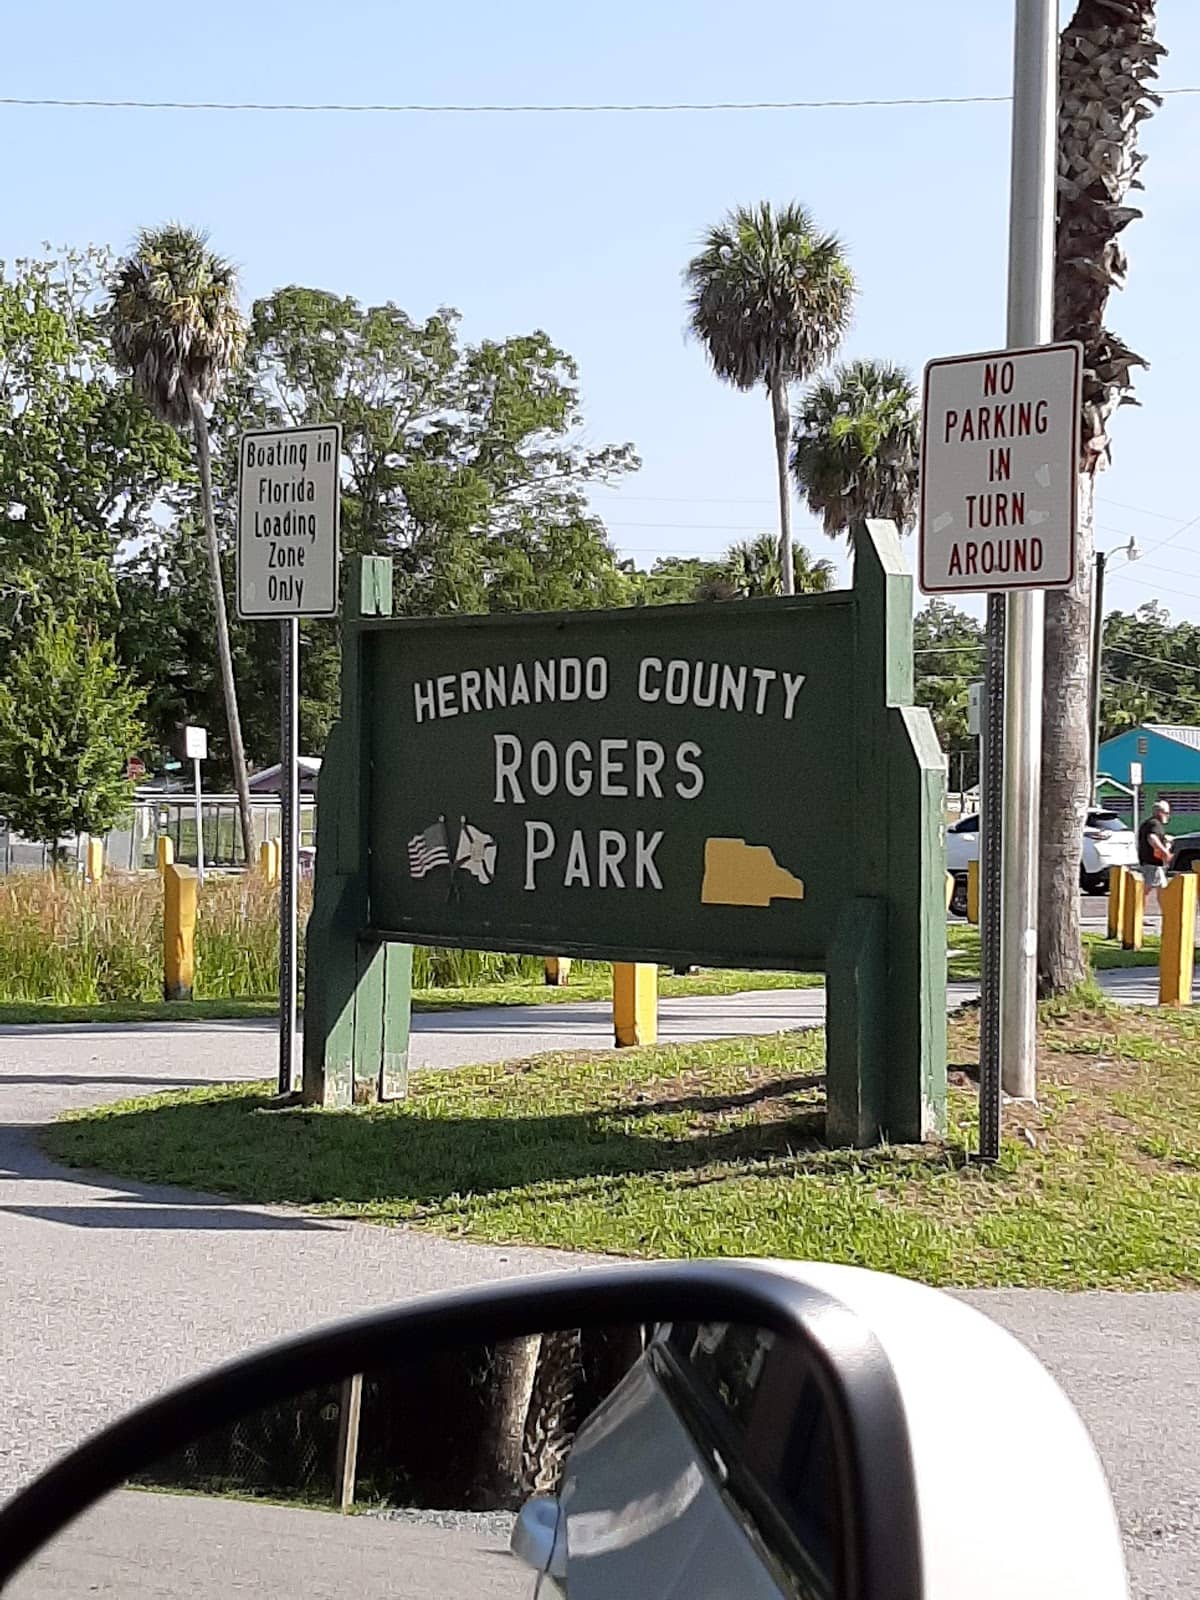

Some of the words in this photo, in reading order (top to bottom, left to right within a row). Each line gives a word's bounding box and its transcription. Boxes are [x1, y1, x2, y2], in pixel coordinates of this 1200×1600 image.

[984, 361, 1014, 397] NO
[945, 400, 1048, 443] PARKING
[247, 440, 307, 471] Boating
[317, 435, 331, 463] in
[988, 448, 1010, 482] IN
[259, 477, 314, 505] Florida
[255, 510, 316, 543] Loading
[966, 492, 1024, 528] TURN
[268, 541, 305, 568] Zone
[948, 538, 1042, 576] AROUND
[268, 574, 303, 608] Only
[414, 656, 607, 723] HERNANDO
[638, 657, 805, 720] COUNTY
[493, 734, 704, 804] ROGERS
[524, 820, 664, 891] PARK
